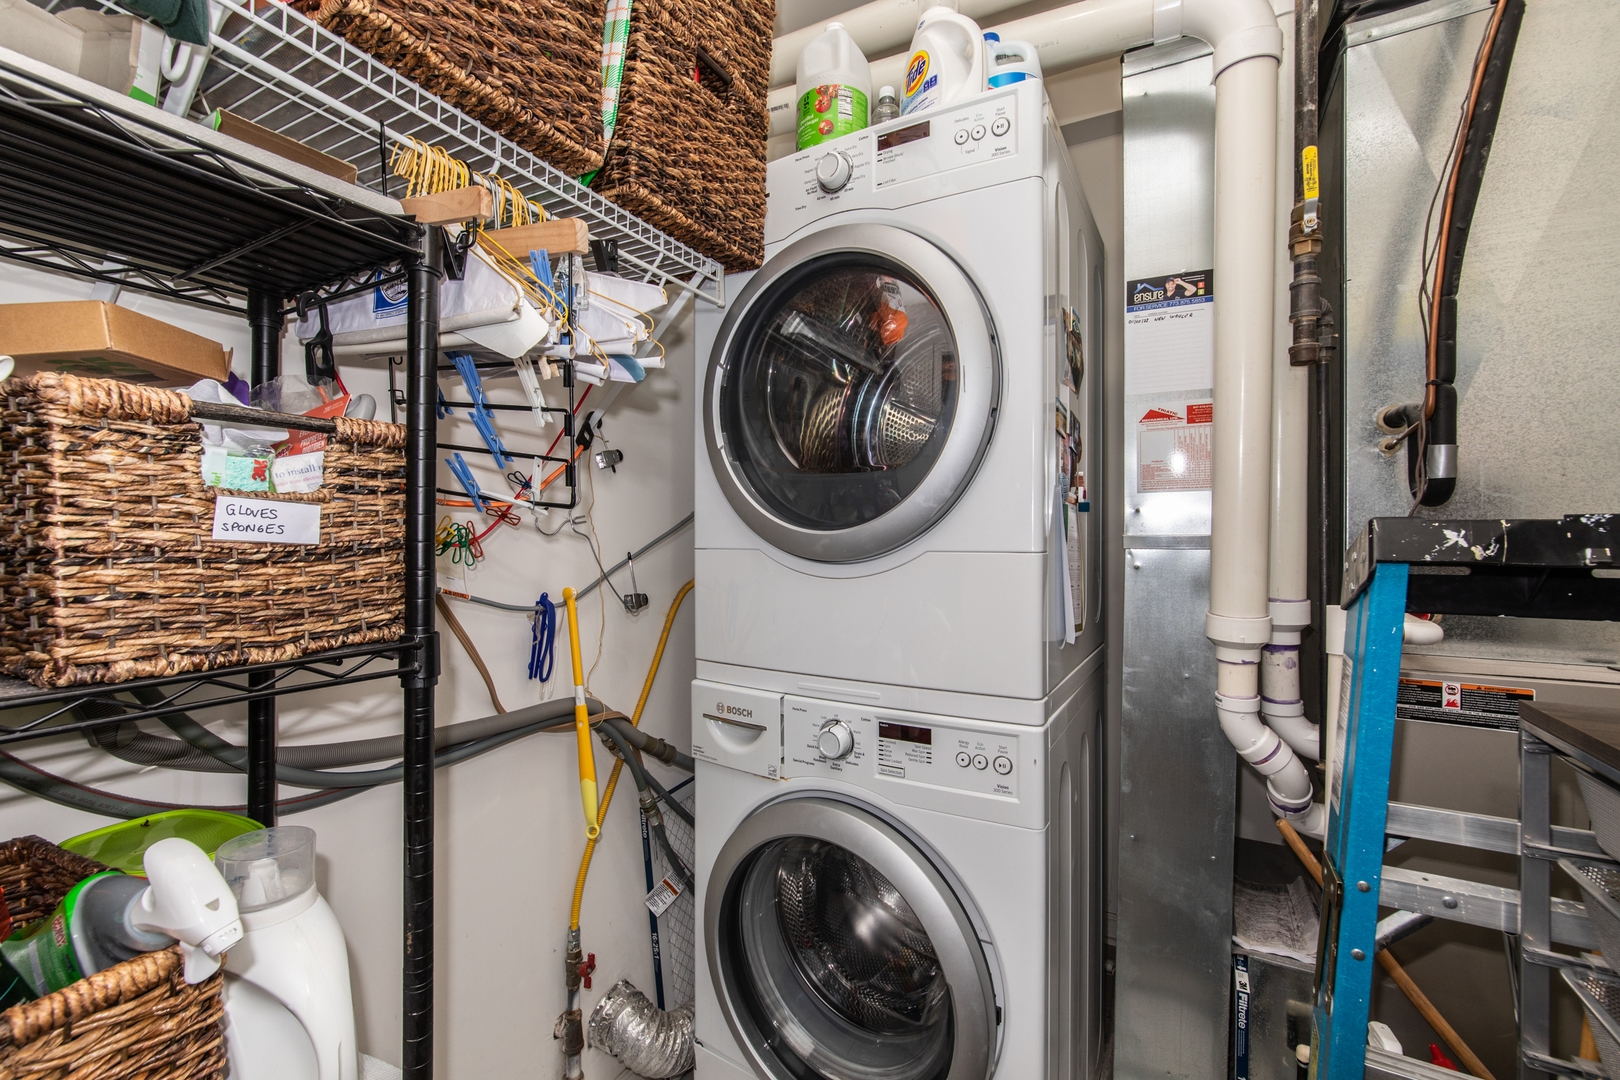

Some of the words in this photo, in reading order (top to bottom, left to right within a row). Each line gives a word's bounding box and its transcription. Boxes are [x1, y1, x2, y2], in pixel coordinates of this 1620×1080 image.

[906, 57, 926, 95] Tide
[1134, 290, 1164, 302] ensure
[1134, 304, 1145, 312] FOR
[1146, 302, 1168, 310] SERVICE
[287, 464, 316, 476] install
[226, 504, 278, 519] GLOVES
[221, 522, 285, 534] SPONGES
[726, 705, 753, 718] BOSCH
[1238, 980, 1248, 990] 3M
[1239, 993, 1248, 1029] Filtrete
